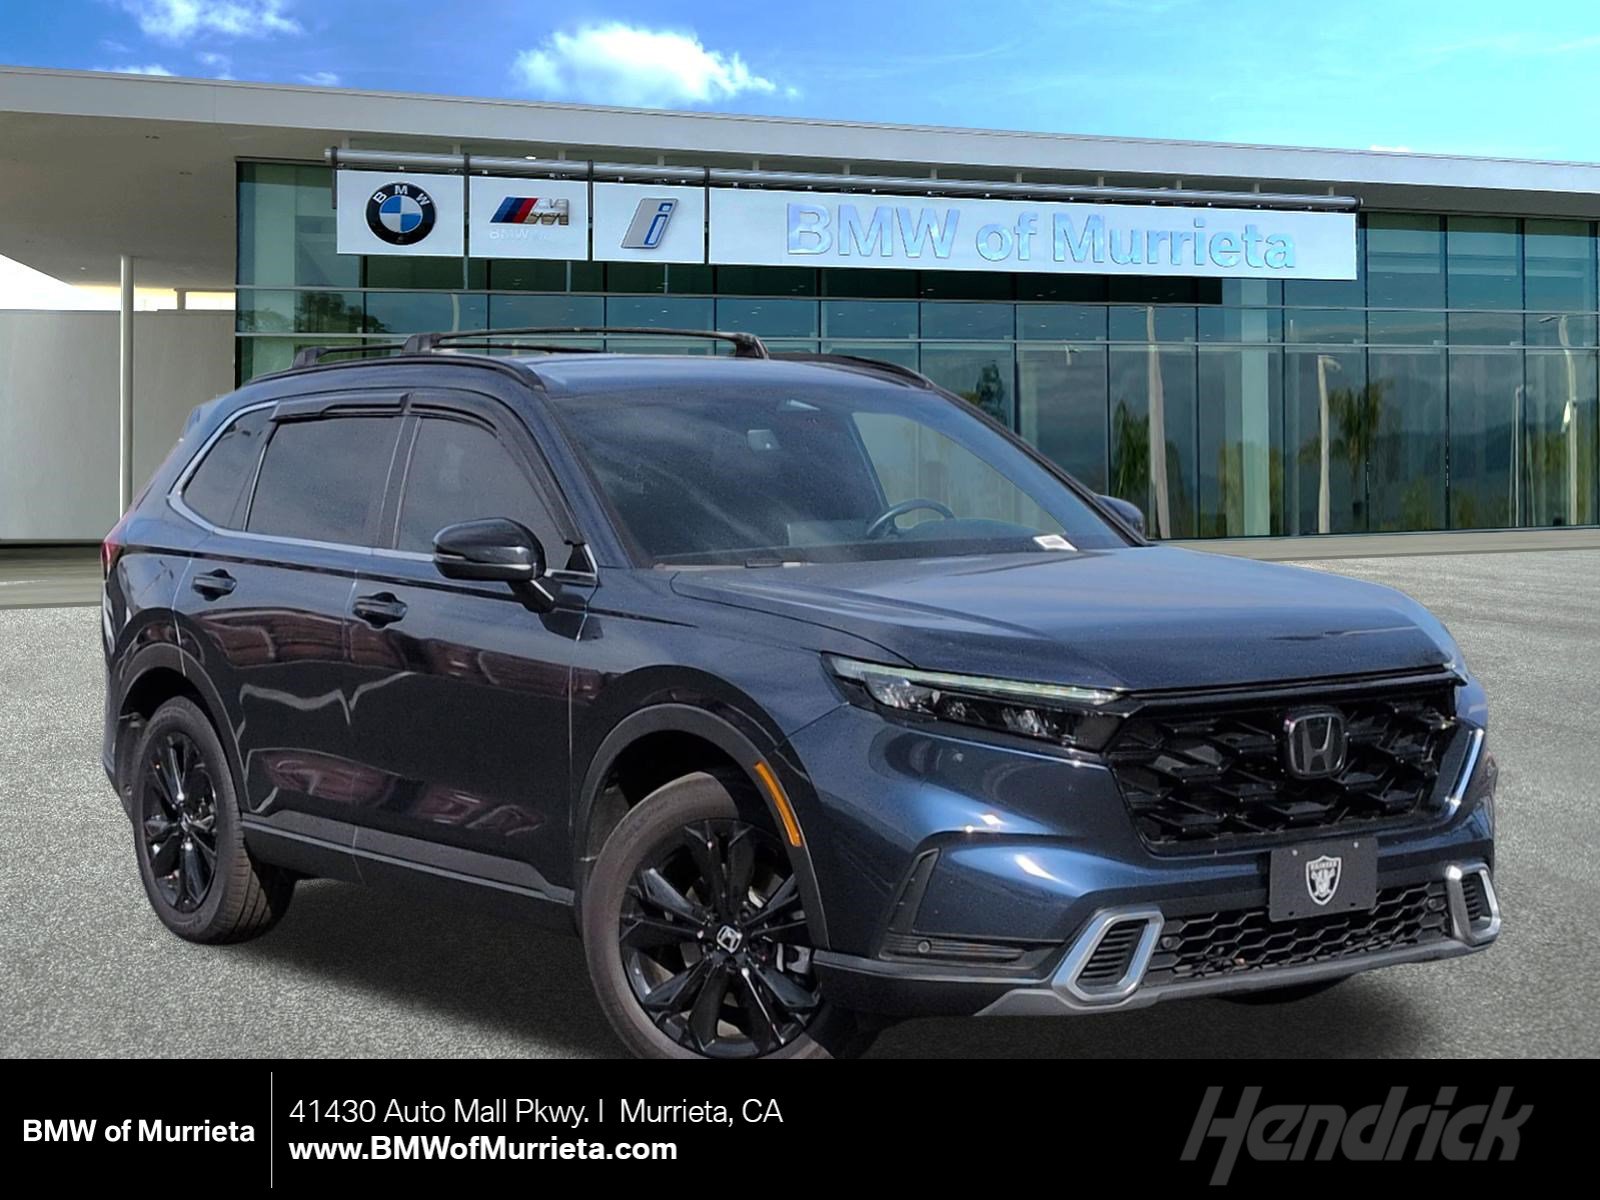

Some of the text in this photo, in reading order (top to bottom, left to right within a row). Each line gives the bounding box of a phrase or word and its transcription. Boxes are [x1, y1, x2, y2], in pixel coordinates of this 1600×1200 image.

[373, 184, 430, 206] BMW
[786, 202, 1297, 270] BMW of Murrieta
